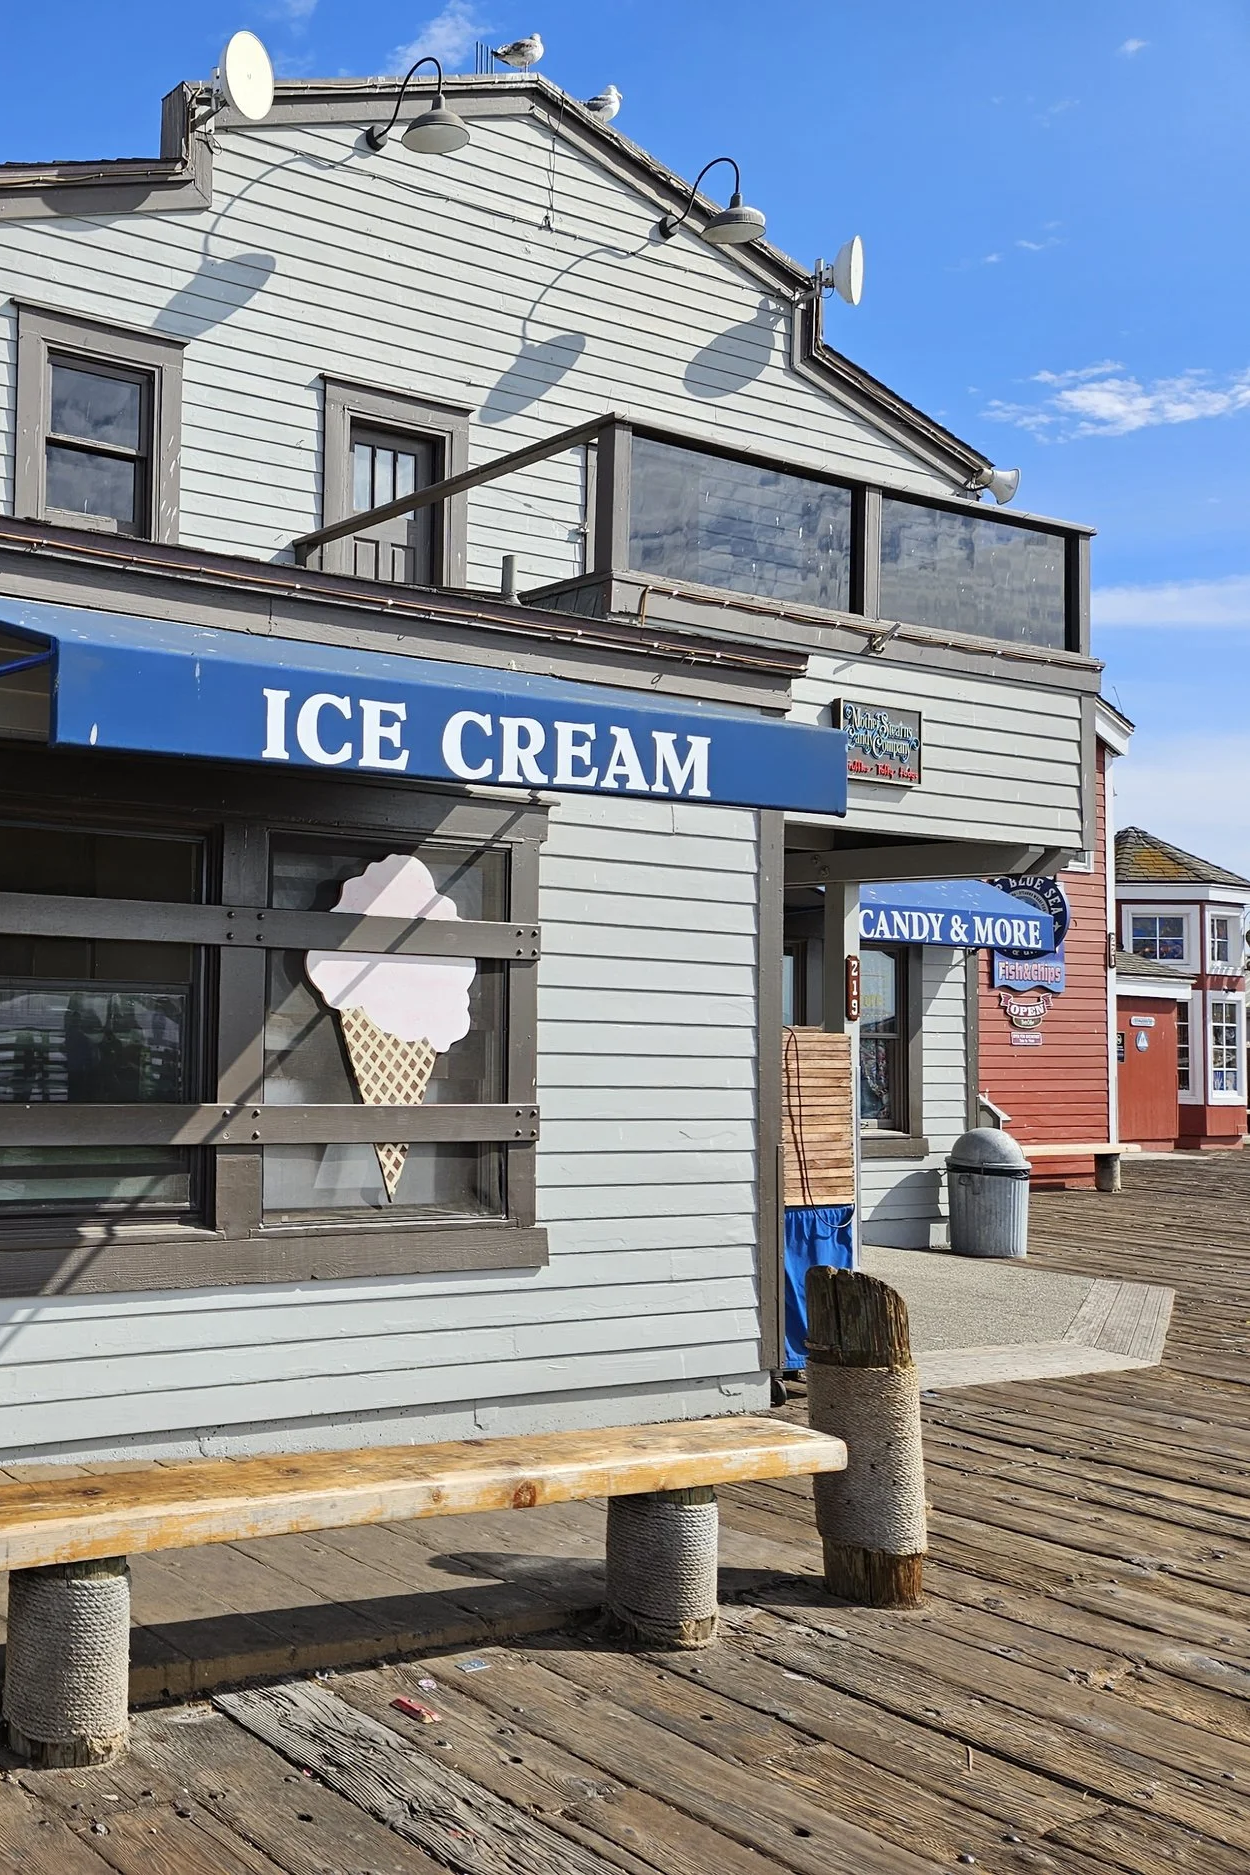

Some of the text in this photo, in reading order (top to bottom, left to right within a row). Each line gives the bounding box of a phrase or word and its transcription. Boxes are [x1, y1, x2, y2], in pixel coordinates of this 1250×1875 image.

[261, 687, 712, 798] ICE CREAM
[872, 734, 919, 763] Company
[1009, 876, 1045, 891] BLUE
[1044, 888, 1063, 915] SEA
[859, 908, 1042, 948] CANDY & MORE
[851, 960, 859, 1016] 219
[1010, 1004, 1045, 1017] OPEN
